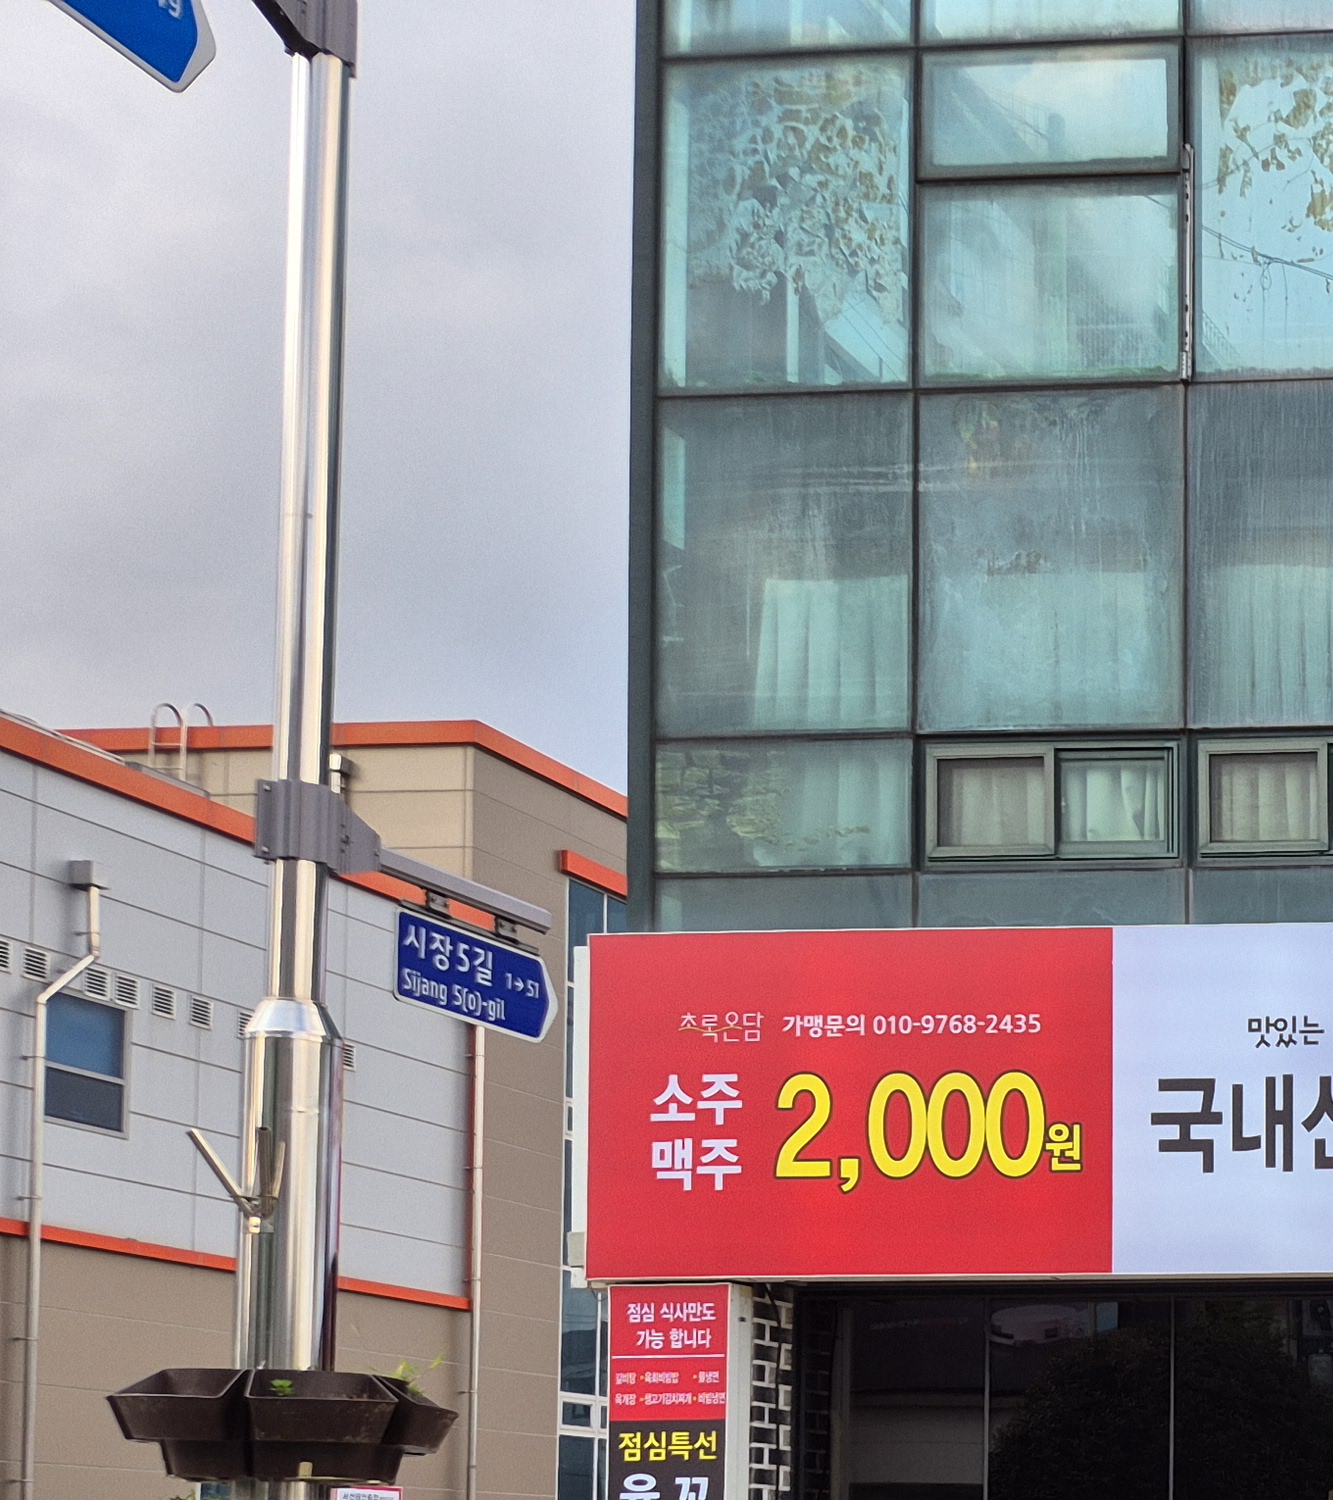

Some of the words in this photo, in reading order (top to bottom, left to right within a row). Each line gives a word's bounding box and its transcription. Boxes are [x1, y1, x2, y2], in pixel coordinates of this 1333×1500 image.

[403, 924, 493, 987] 시장5길
[402, 968, 448, 1006] Sijang
[452, 983, 506, 1021] 5(o)-gil
[678, 1011, 764, 1043] 초록온담
[782, 1014, 866, 1038] 가맹문의
[873, 1013, 1041, 1036] 010-9768-2435
[1247, 1015, 1325, 1048] 맛있는
[649, 1073, 743, 1126] 소주
[775, 1070, 1083, 1194] 2,000원
[650, 1137, 742, 1191] 맥주
[627, 1302, 655, 1323] 점심
[660, 1302, 716, 1323] 식사만도
[636, 1329, 665, 1349] 가능
[669, 1328, 712, 1348] 합니다
[618, 1430, 717, 1462] 점심특선
